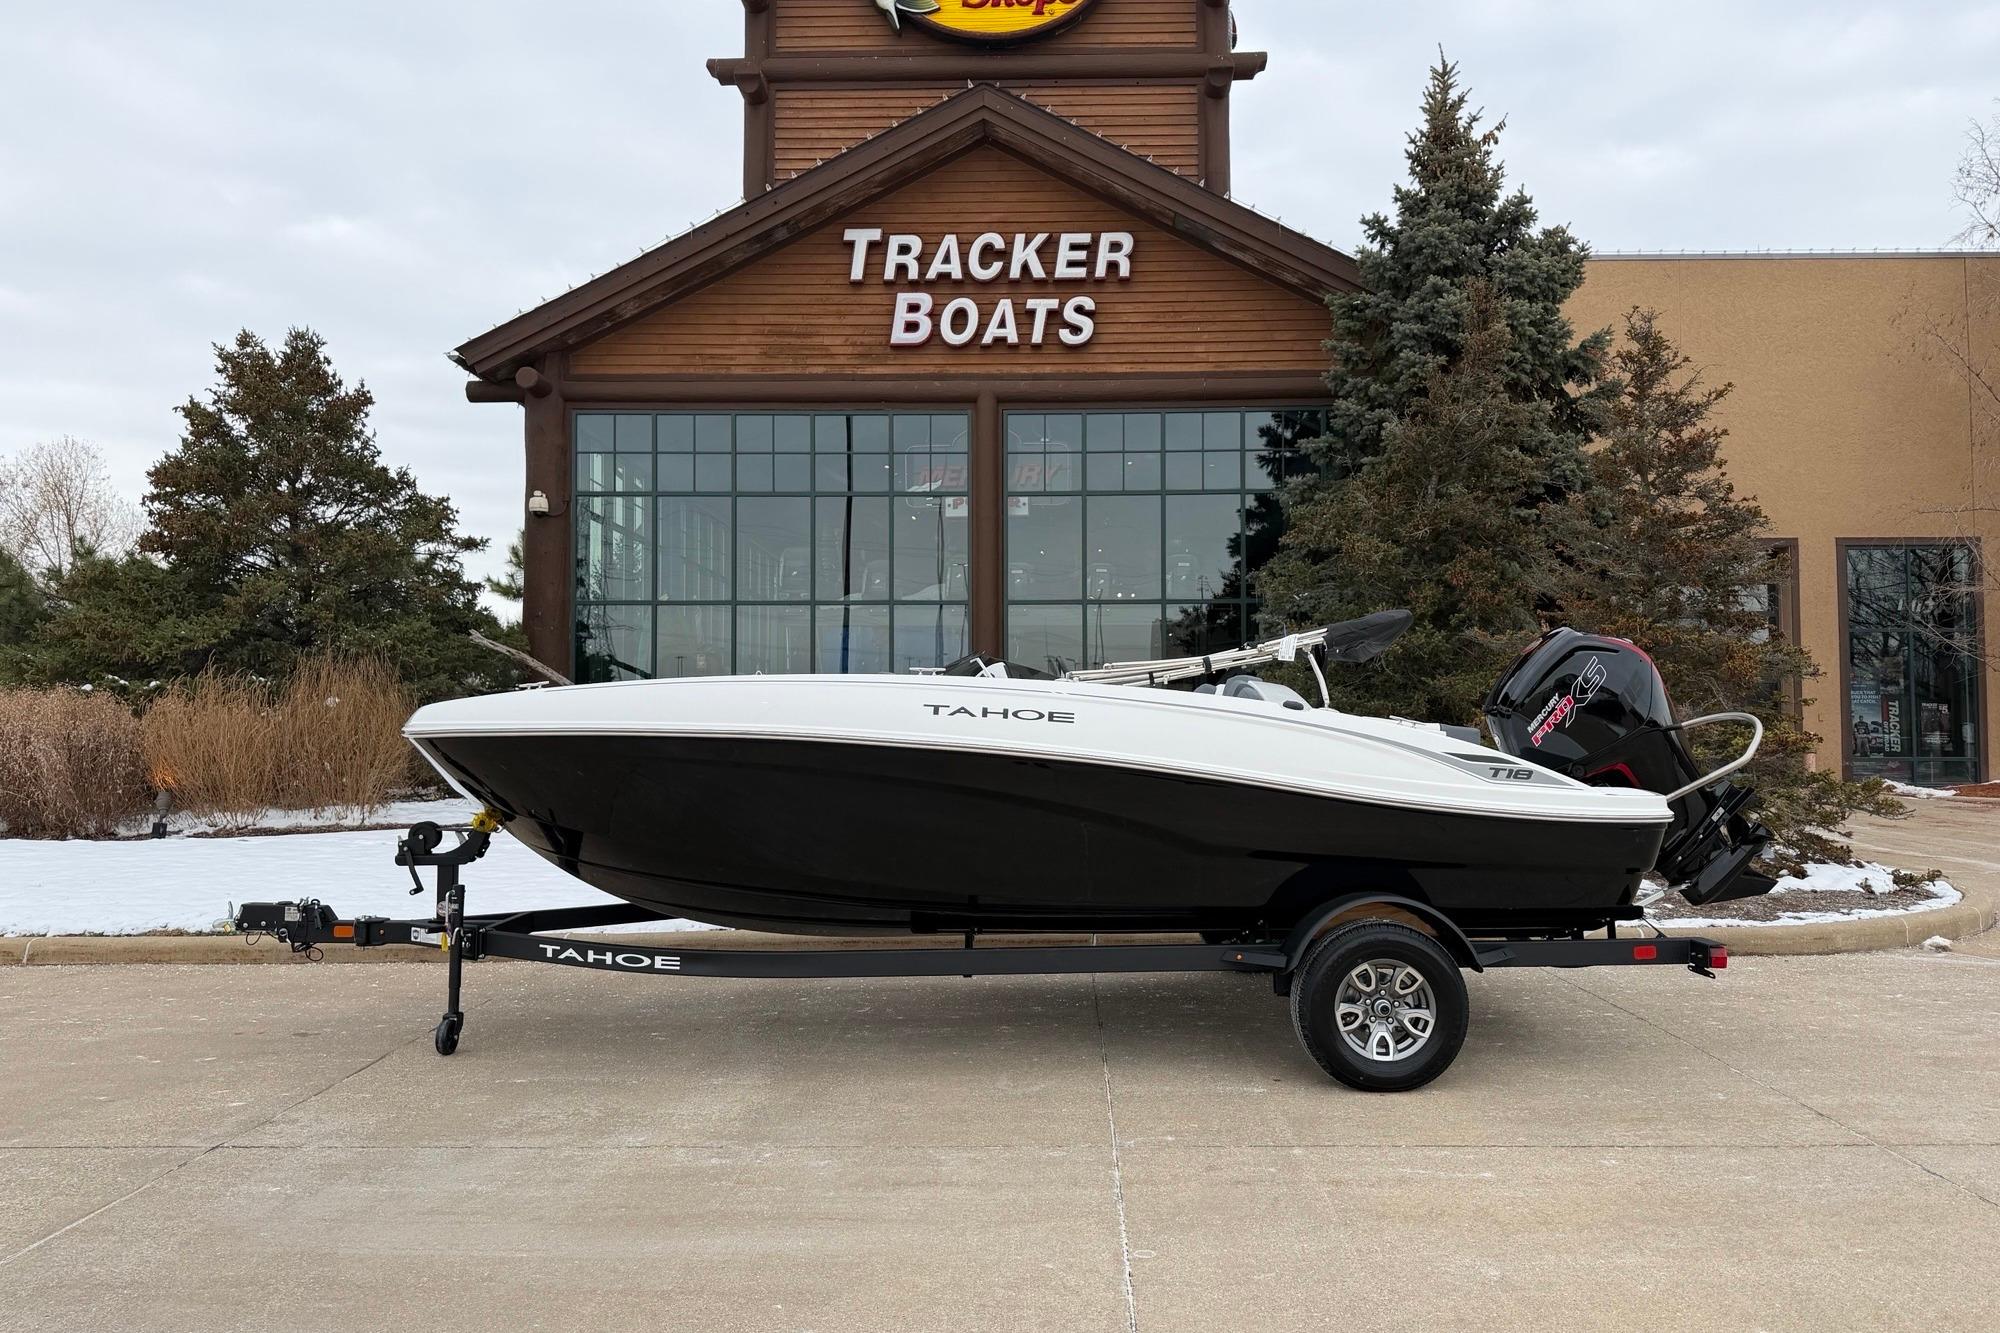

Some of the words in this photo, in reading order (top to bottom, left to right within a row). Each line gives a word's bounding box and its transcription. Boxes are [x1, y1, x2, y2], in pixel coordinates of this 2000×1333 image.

[843, 228, 1135, 283] TRACKER
[890, 292, 1097, 347] BOATS
[923, 704, 1075, 723] TAHOE
[1527, 692, 1560, 734] MERCURY
[1888, 700, 1901, 752] TRACKER
[1489, 767, 1534, 780] T18
[539, 944, 681, 970] TAHOE
